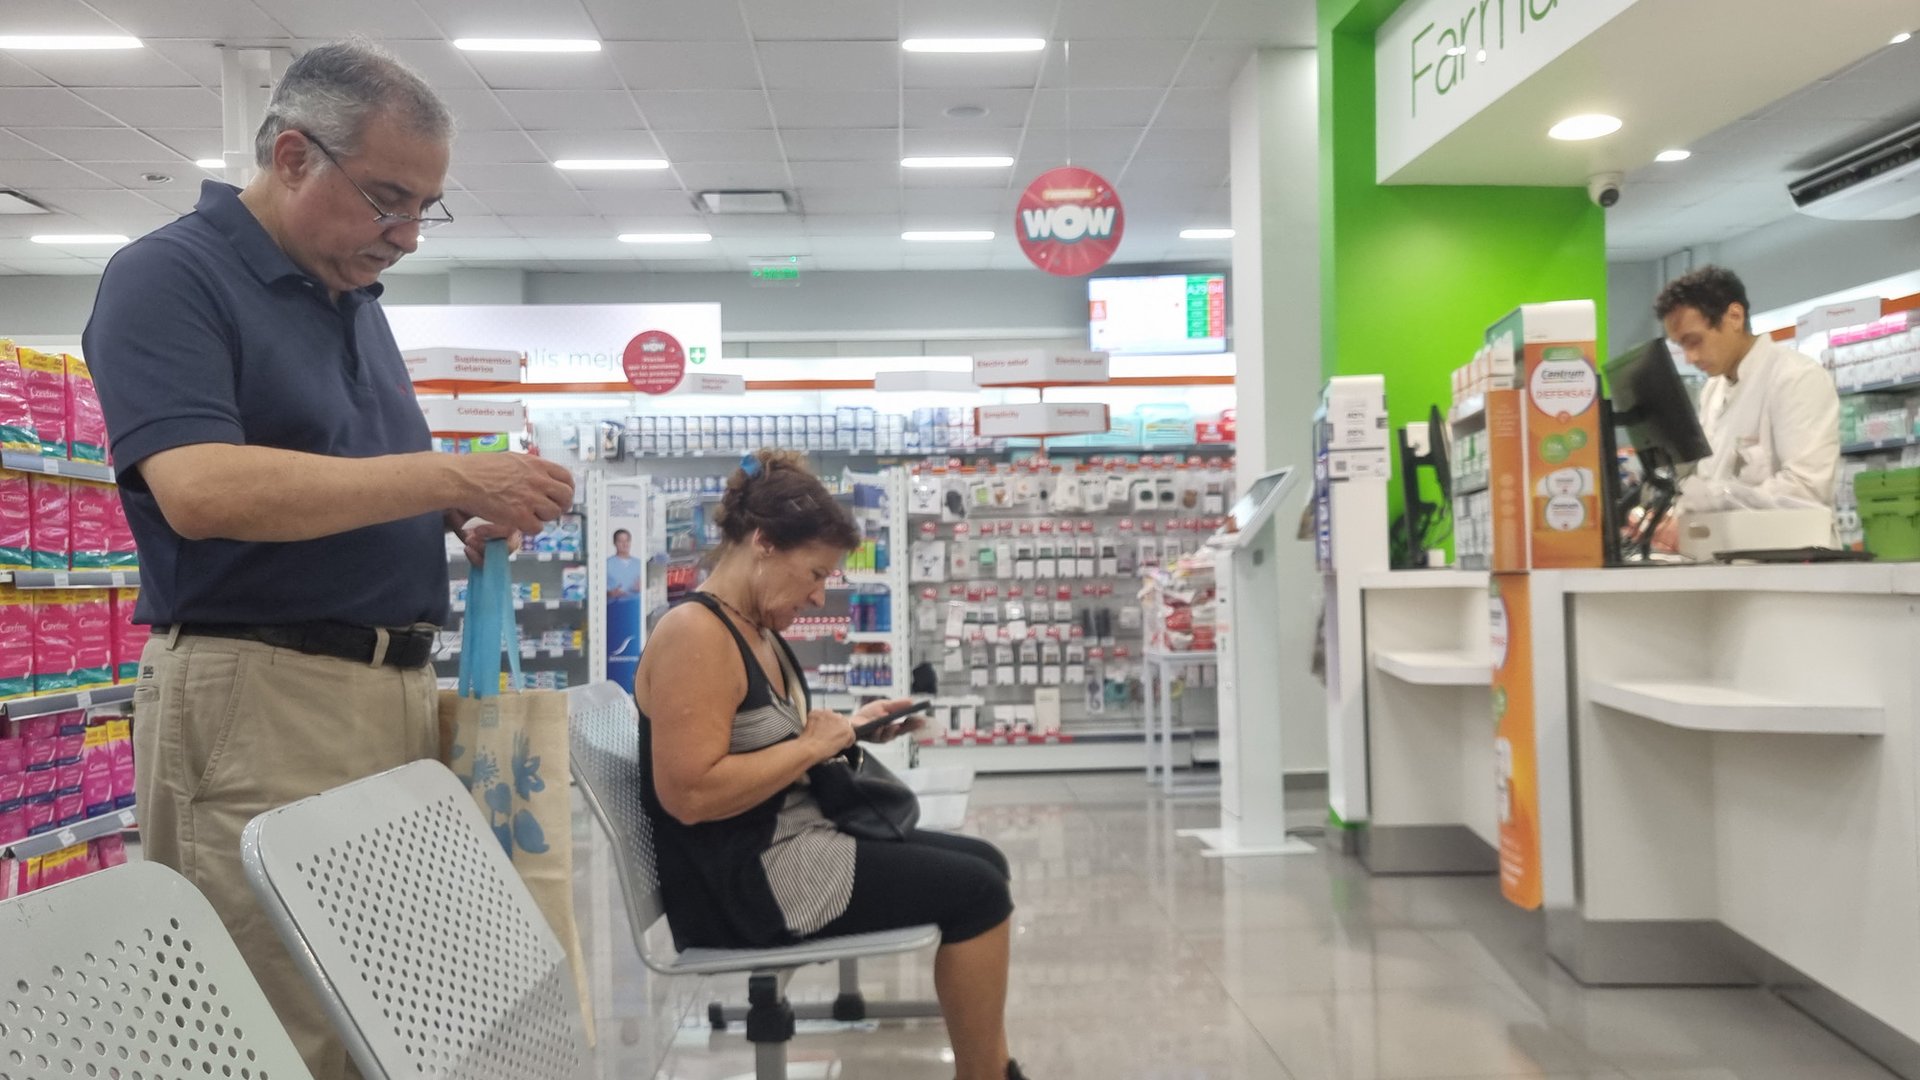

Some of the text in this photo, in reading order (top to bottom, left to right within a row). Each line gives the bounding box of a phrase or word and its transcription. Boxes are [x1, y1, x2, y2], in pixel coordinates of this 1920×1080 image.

[1411, 0, 1558, 118] Farm
[1022, 204, 1116, 242] WOW
[453, 354, 512, 367] Suplementos
[454, 364, 494, 374] dietarios
[1541, 369, 1585, 380] Centrum
[457, 407, 515, 417] Cuidado oral
[0, 622, 27, 634] Carefree
[41, 619, 69, 632] Carefree
